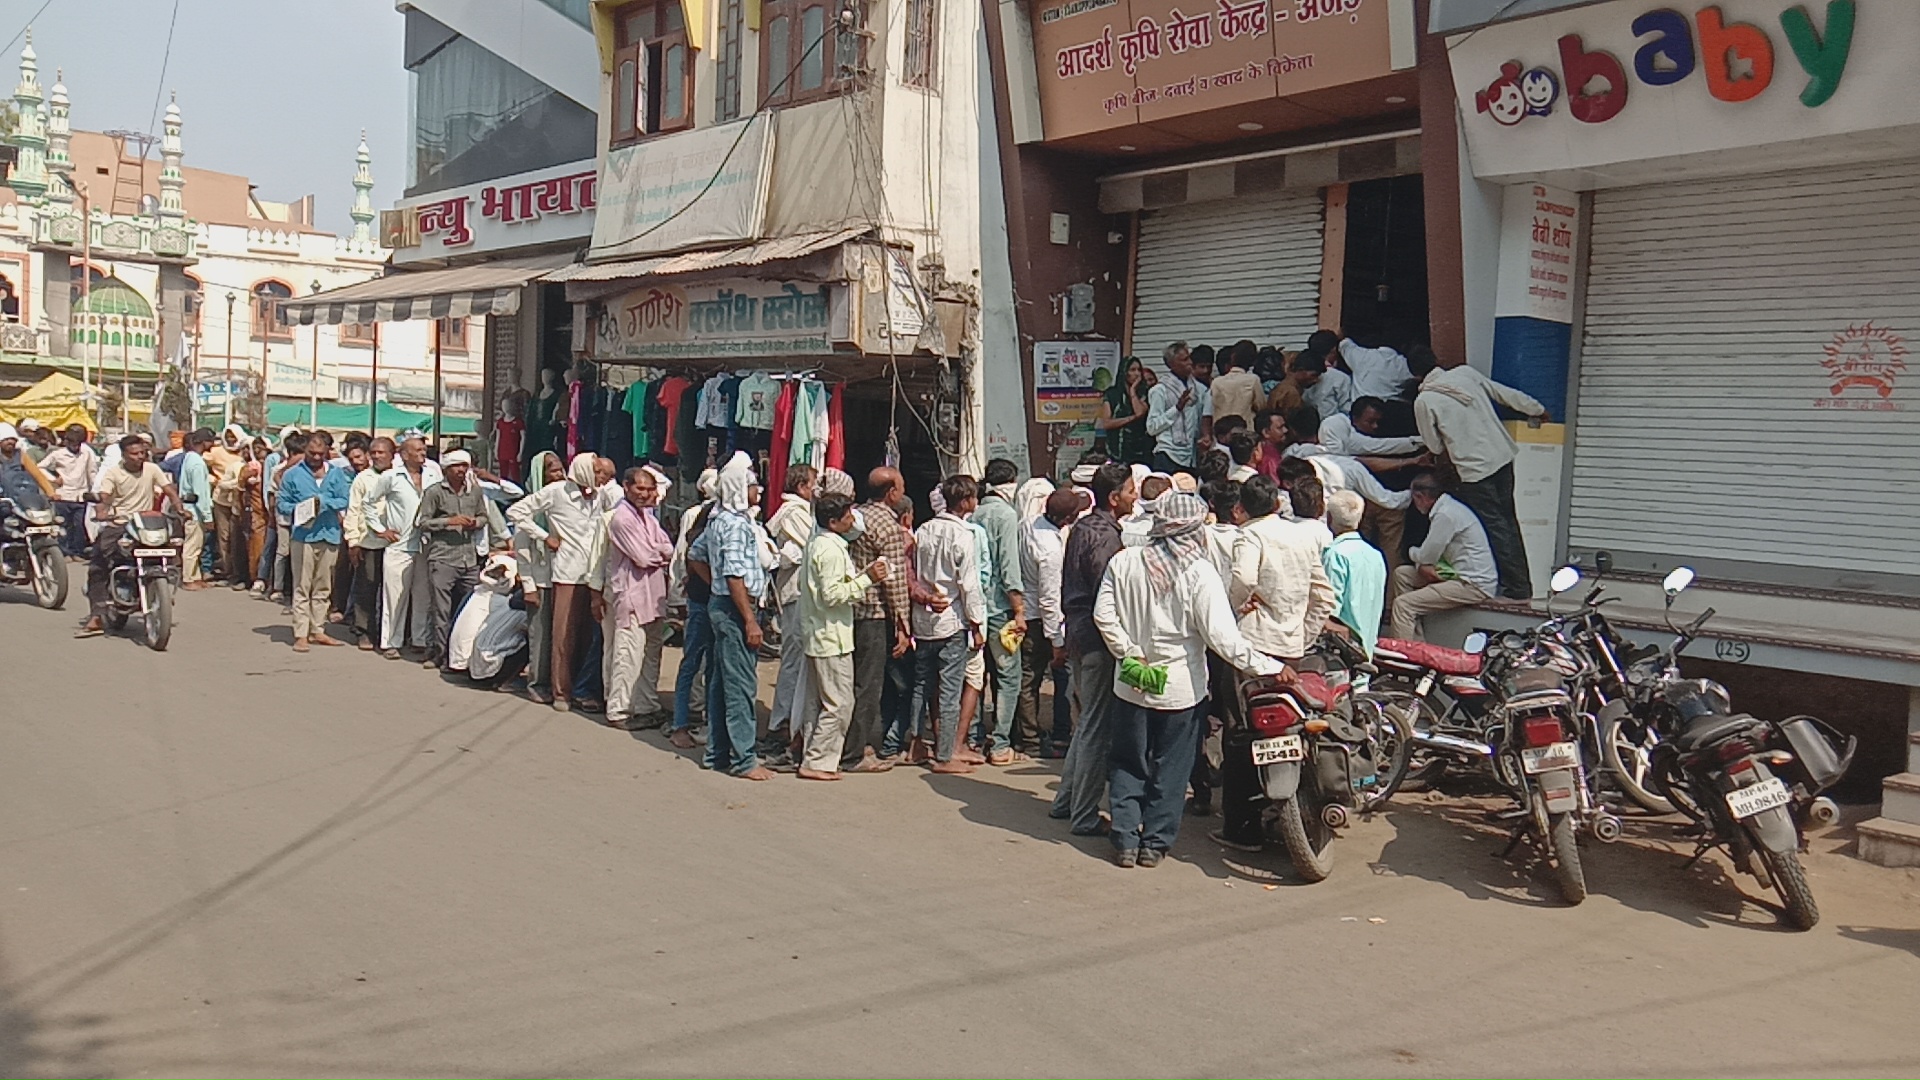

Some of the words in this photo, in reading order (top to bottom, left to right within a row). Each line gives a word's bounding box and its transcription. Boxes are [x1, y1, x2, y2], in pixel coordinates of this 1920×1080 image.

[1057, 27, 1112, 77] आदर्श
[1119, 18, 1160, 74] कृषि
[1167, 9, 1211, 54] सेवा
[1219, 0, 1267, 40] केन्द्र
[1558, 0, 1856, 123] baby
[1104, 93, 1128, 114] कृषि
[1164, 76, 1195, 98] दवाई
[1199, 79, 1209, 90] व
[1213, 70, 1243, 88] खाद
[1248, 62, 1262, 80] के
[1266, 54, 1314, 77] विक्रेता
[626, 288, 683, 337] गणेश
[689, 288, 759, 332] क्लॉथ
[1719, 642, 1746, 658] 125
[1256, 749, 1300, 762] 7548
